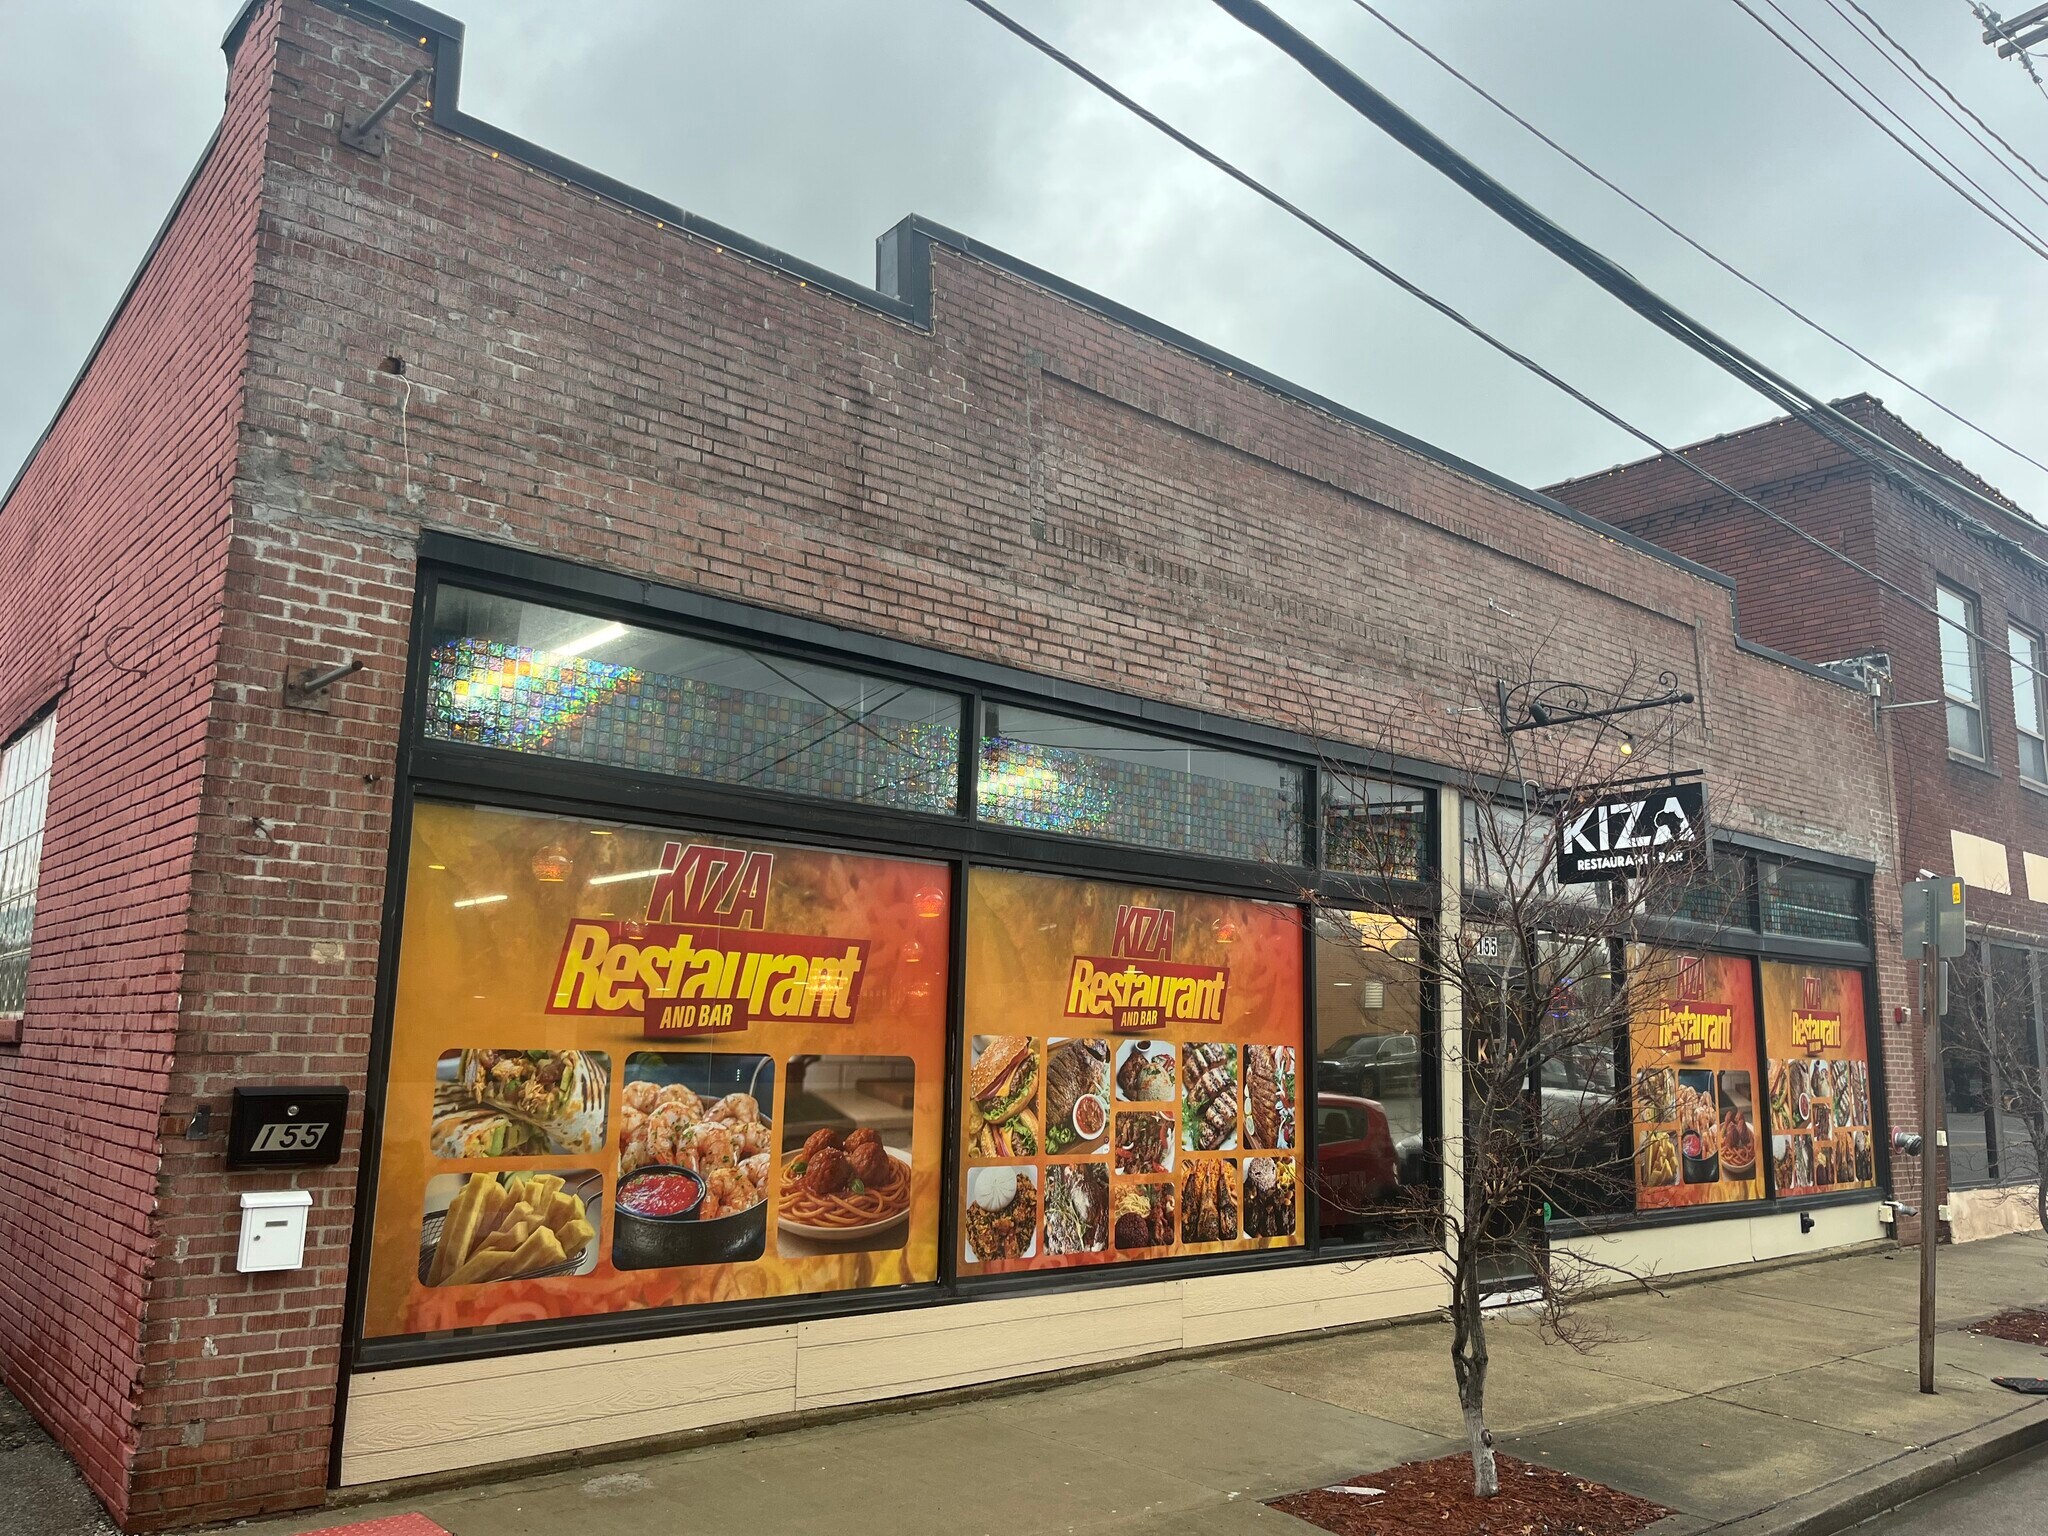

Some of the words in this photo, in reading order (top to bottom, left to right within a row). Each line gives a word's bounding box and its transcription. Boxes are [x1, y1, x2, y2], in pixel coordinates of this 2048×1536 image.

[1563, 797, 1696, 855] KIZA
[1577, 853, 1649, 871] RESTAURANT
[645, 841, 774, 930] KIZA
[1111, 905, 1175, 962] KIZA
[1480, 937, 1496, 955] 155
[552, 923, 861, 1019] Restaurant
[1067, 959, 1226, 1020] Restaurant
[658, 1006, 695, 1029] AND
[698, 1004, 732, 1027] BAR
[1120, 1011, 1138, 1027] AND
[1140, 1010, 1158, 1026] BAR
[1658, 1001, 1732, 1050] Restaurant
[1792, 1011, 1840, 1046] Restaurant
[260, 1125, 324, 1149] 155
